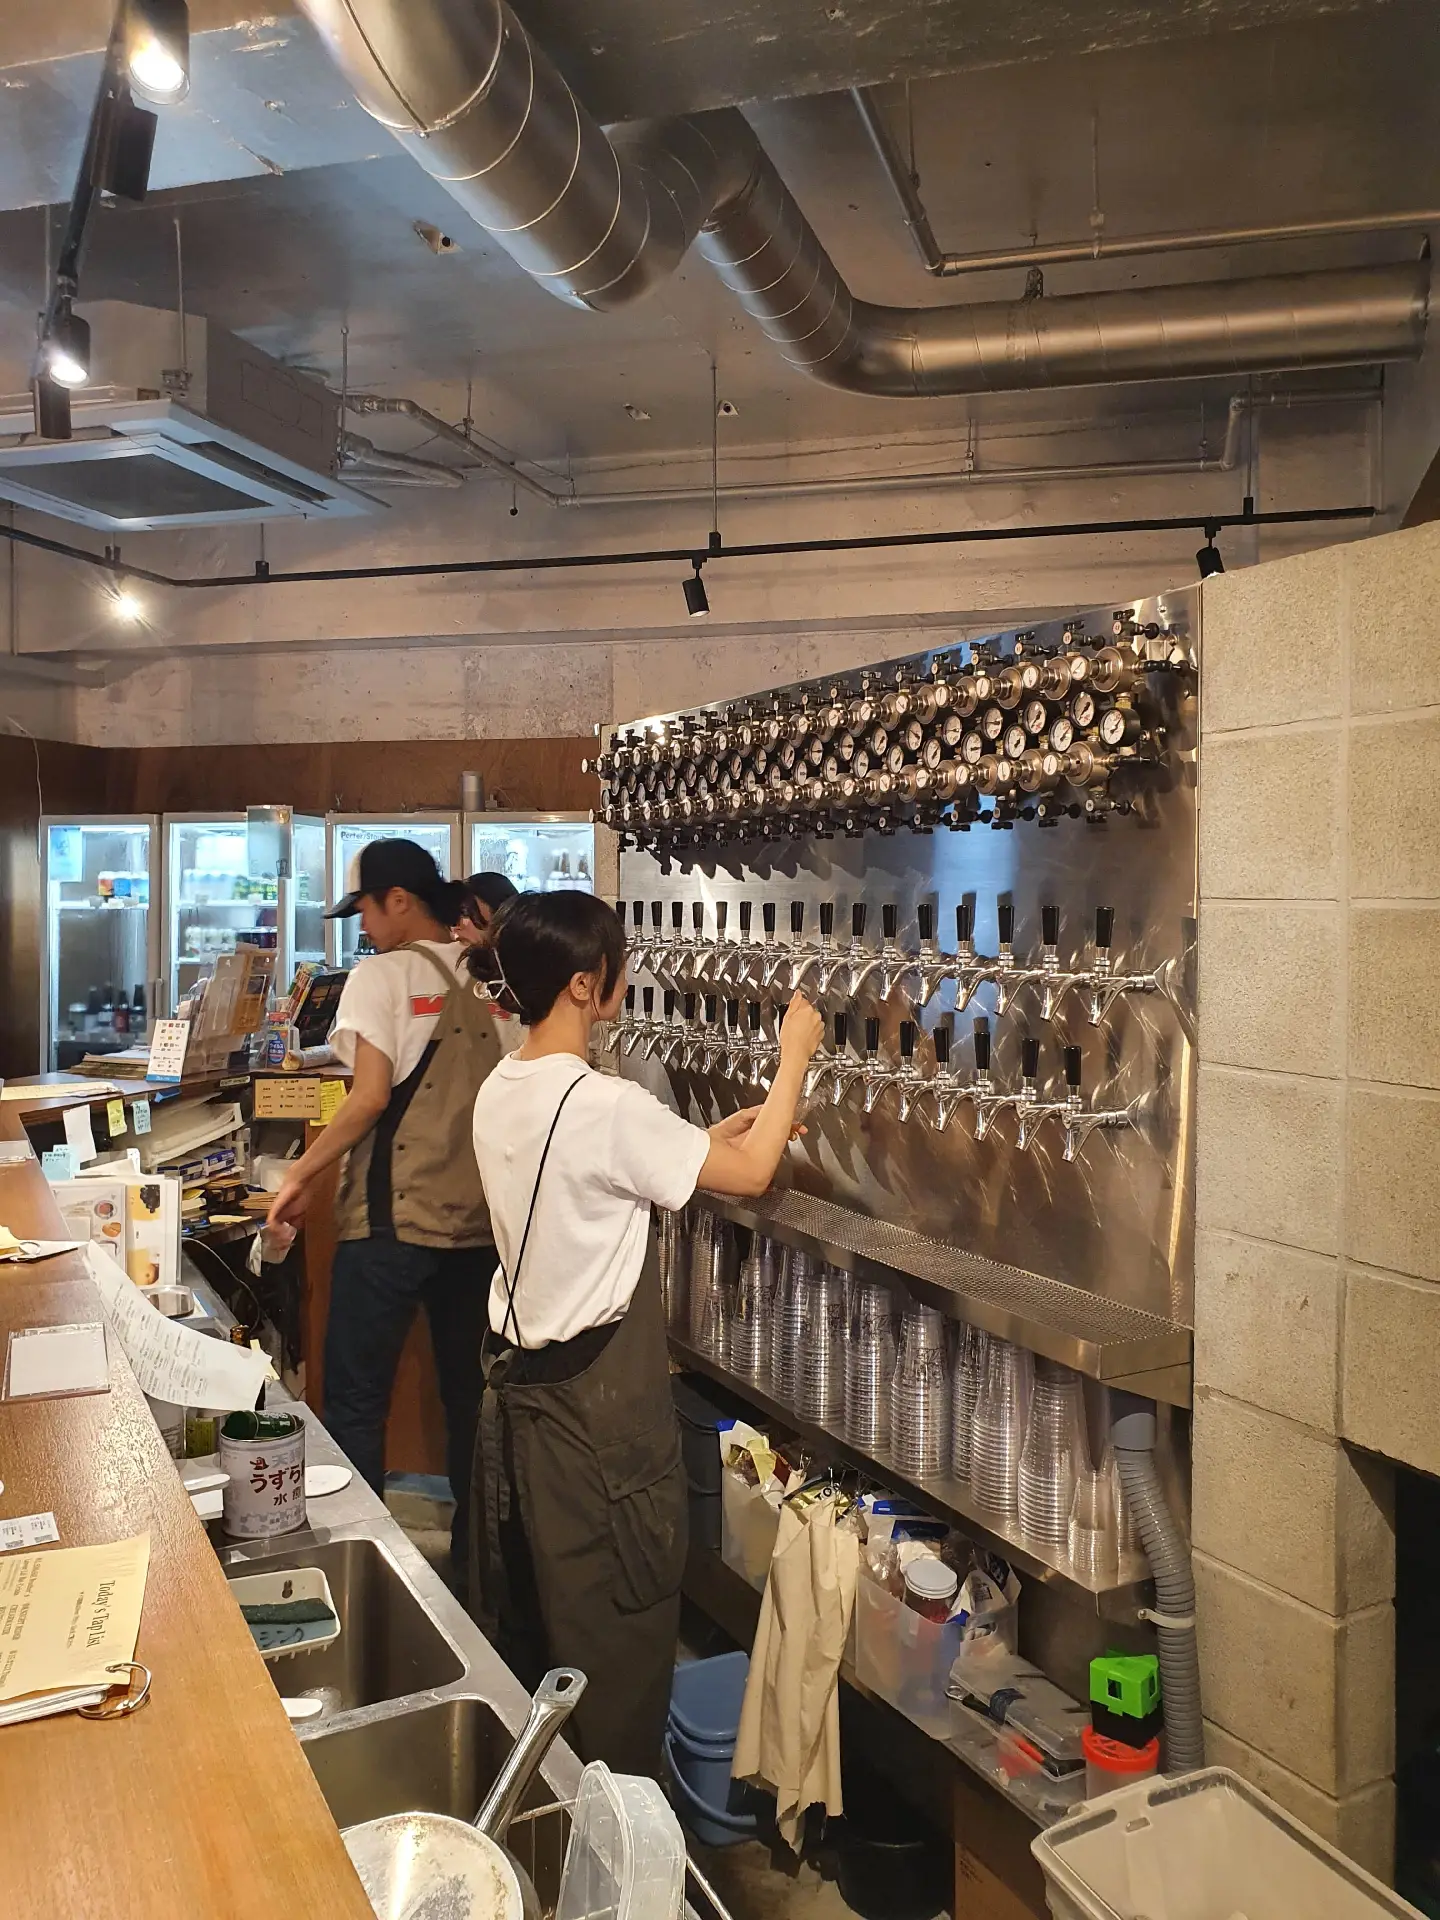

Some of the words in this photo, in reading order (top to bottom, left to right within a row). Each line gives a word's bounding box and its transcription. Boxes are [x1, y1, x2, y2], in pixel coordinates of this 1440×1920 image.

[91, 1580, 116, 1614] Today's
[86, 1613, 110, 1630] Tap
[86, 1630, 106, 1648] List
